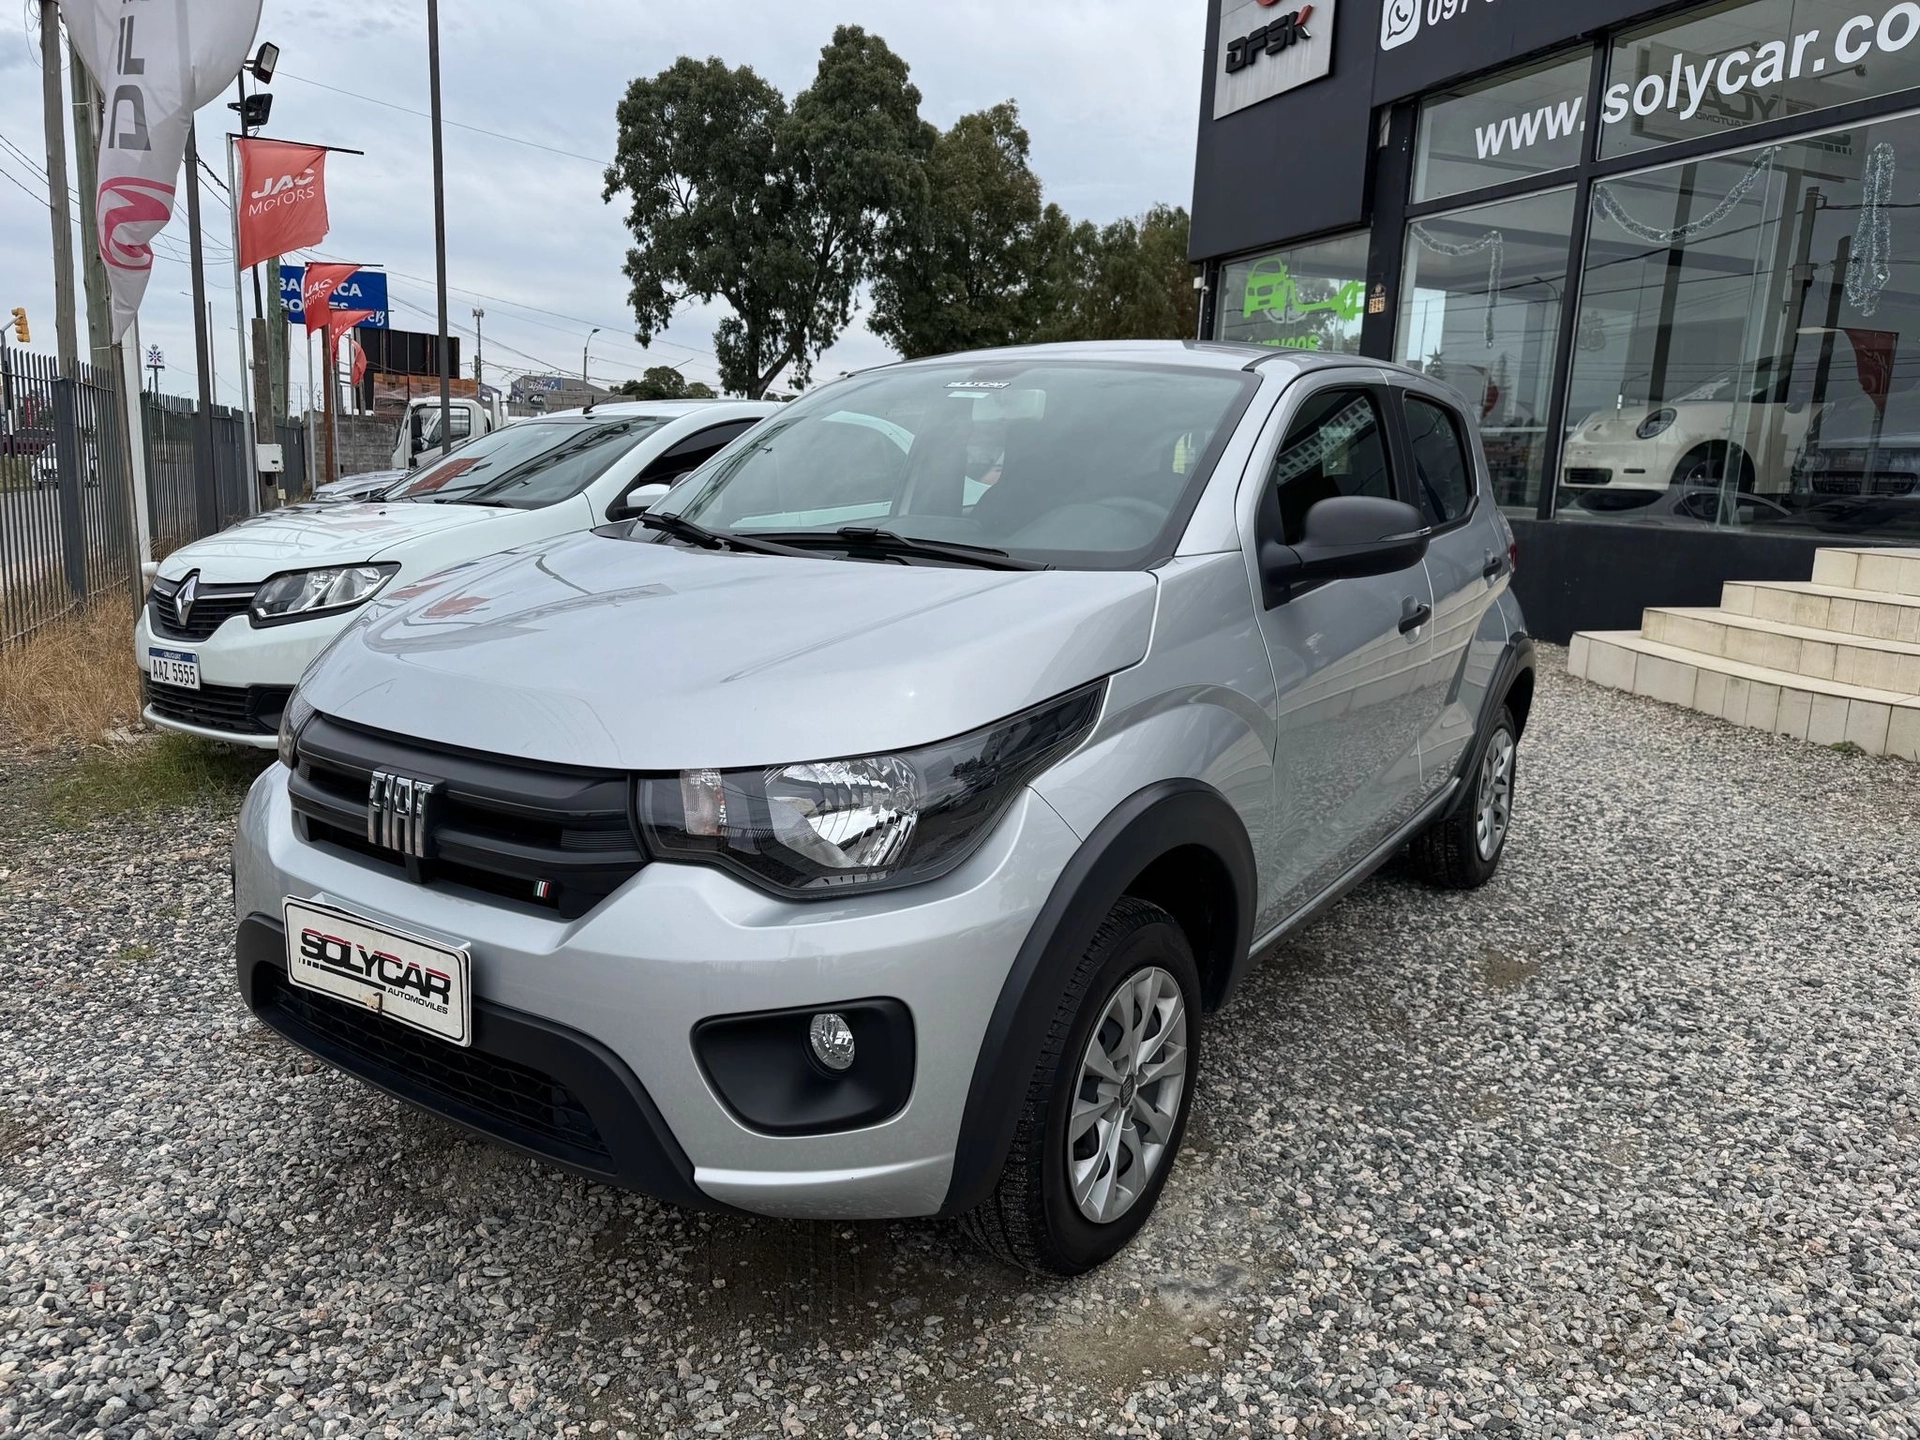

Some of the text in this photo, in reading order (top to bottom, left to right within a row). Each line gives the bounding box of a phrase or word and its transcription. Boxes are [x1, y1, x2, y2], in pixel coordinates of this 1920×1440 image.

[1225, 4, 1314, 74] DFSK
[251, 168, 315, 199] JAC
[248, 186, 315, 217] MOTORS
[153, 659, 196, 685] AAZ 5555
[367, 770, 434, 858] FIAT
[300, 927, 452, 1006] SOLYCAR
[387, 987, 449, 1015] AUTOMOVILES
